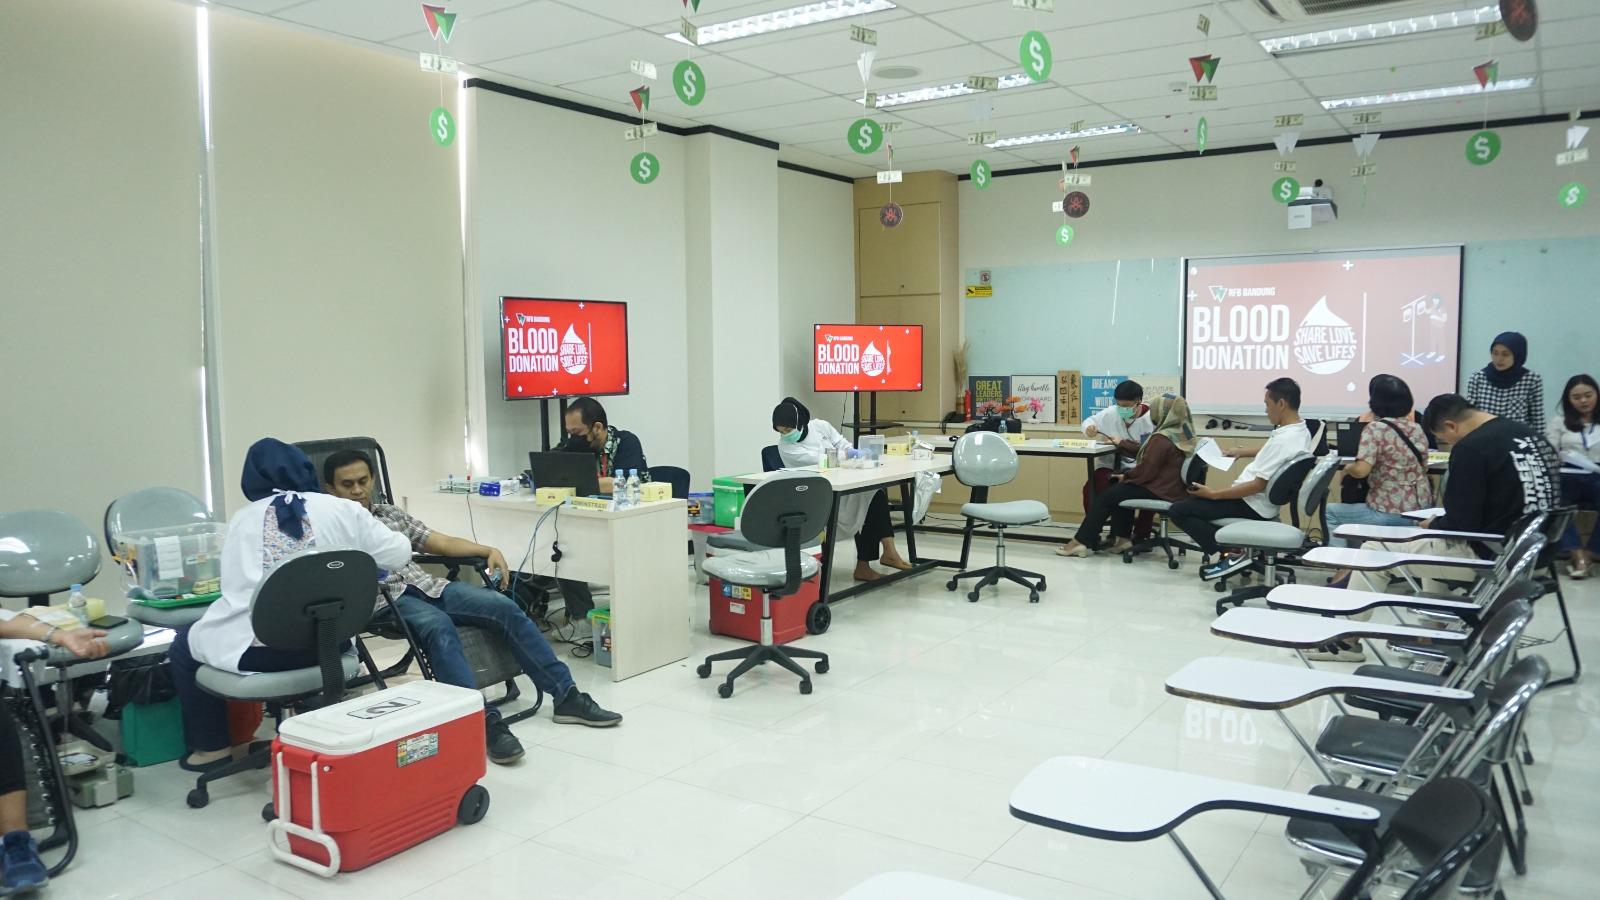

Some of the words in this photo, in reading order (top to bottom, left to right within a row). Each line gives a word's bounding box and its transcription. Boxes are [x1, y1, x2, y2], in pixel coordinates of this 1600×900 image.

[1192, 304, 1290, 343] BLOOD
[508, 328, 558, 354] BLOOD
[1293, 327, 1328, 346] SHARE
[1329, 326, 1357, 345] LOVE
[818, 343, 860, 362] BLOOD
[1192, 344, 1289, 370] DONATION
[1294, 345, 1324, 364] SAVE
[1325, 345, 1357, 361] LIFES
[509, 355, 559, 373] DONATION
[818, 362, 860, 375] DONATION
[976, 381, 1002, 390] GREAT
[1092, 378, 1117, 389] DREAMS
[1509, 451, 1538, 514] STREET
[1525, 453, 1548, 511] GHTER
